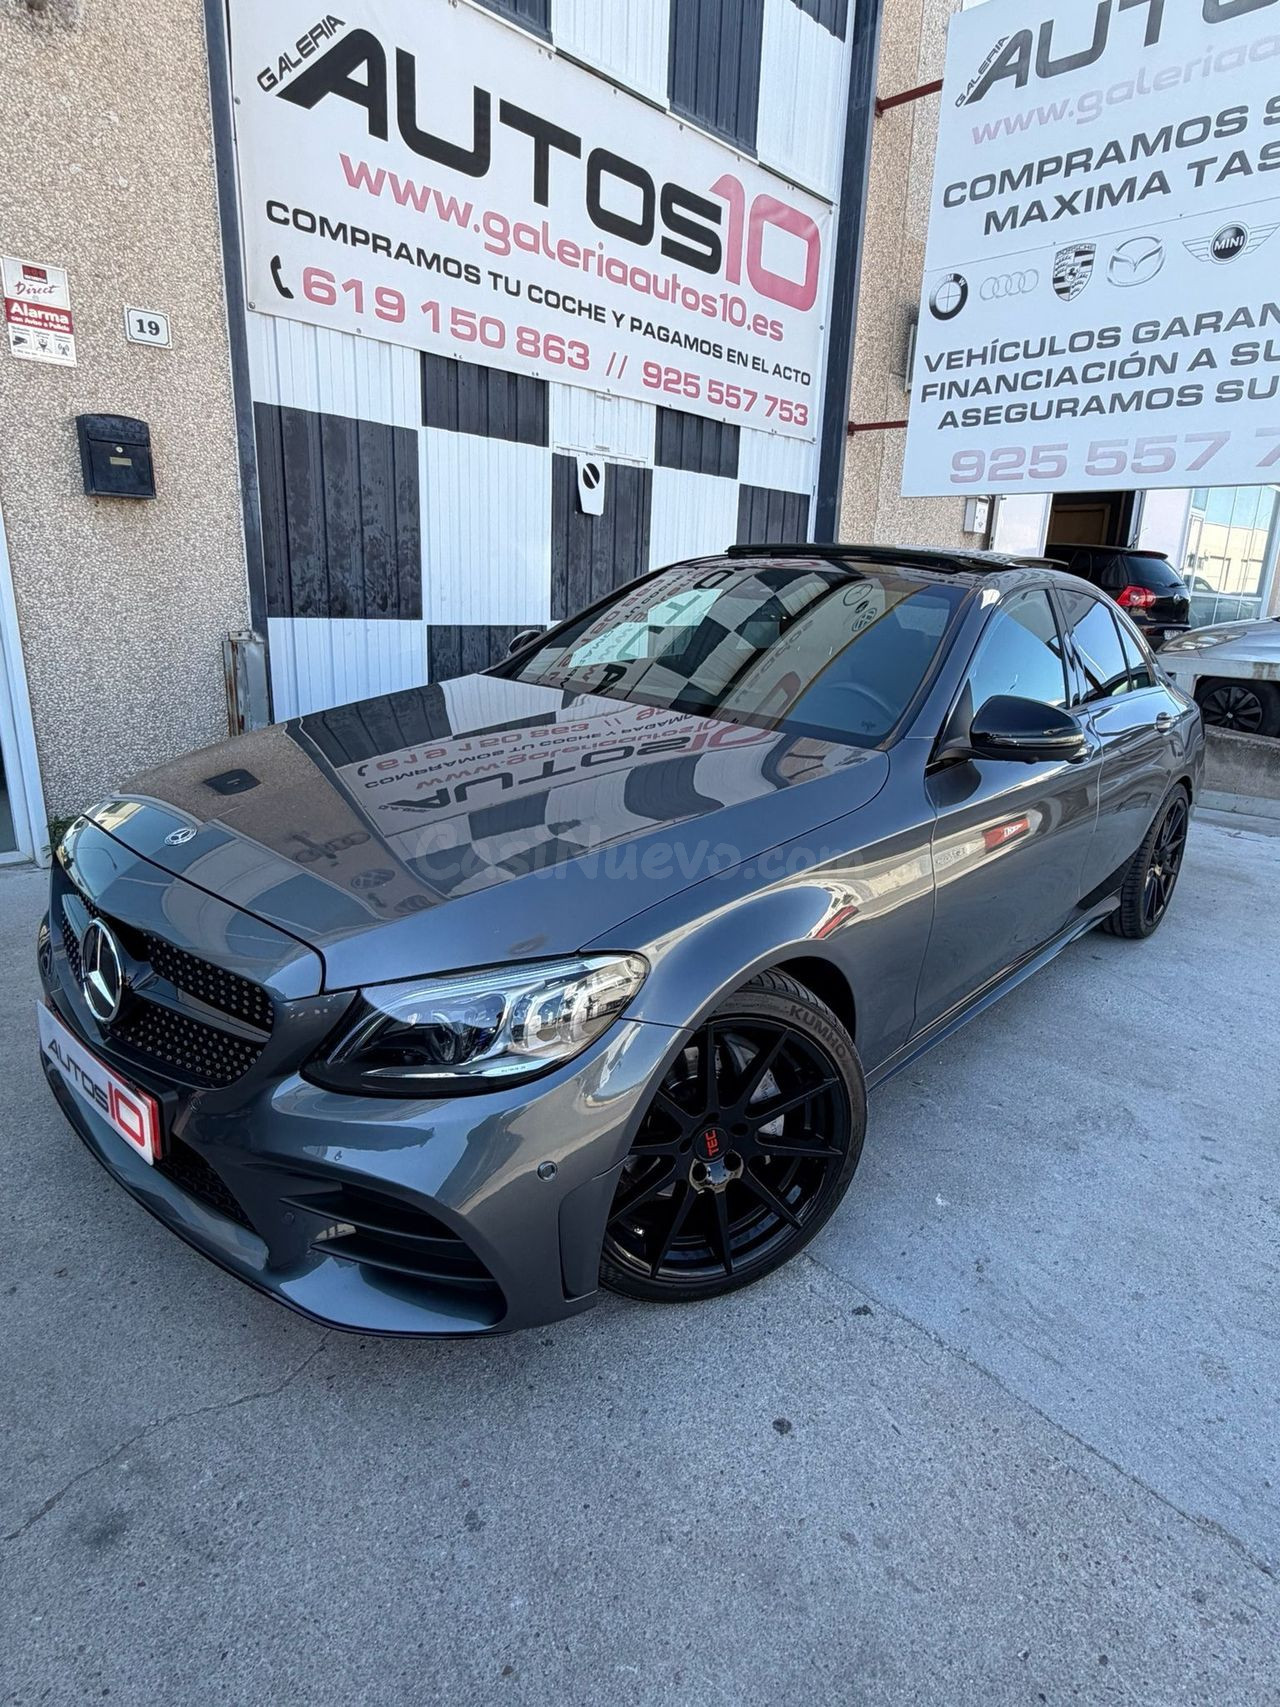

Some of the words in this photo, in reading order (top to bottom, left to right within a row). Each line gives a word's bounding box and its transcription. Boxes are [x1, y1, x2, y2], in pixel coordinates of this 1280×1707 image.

[257, 14, 346, 93] GALERIA
[955, 35, 1010, 107] GALERIA
[276, 28, 820, 312] AUTOS10
[943, 105, 1249, 209] COMPRAMOS
[984, 169, 1172, 237] MAXIMA
[339, 153, 784, 342] www.galeriaautos10.es
[1213, 234, 1245, 251] MINI
[10, 302, 69, 325] Alarma
[15, 281, 57, 295] Direct
[266, 200, 481, 285] COMPRAMOS
[488, 270, 521, 298] TU
[528, 284, 606, 325] COCHE
[612, 309, 625, 330] Y
[630, 316, 722, 359] PAGAMOS
[726, 344, 748, 366] EN
[752, 352, 770, 373] EL
[773, 357, 811, 386] ACTO
[136, 318, 160, 337] 19
[302, 266, 405, 323] 619
[422, 301, 506, 349] 150
[516, 326, 590, 372] 863
[643, 361, 700, 397] 925
[707, 382, 759, 414] 557
[764, 394, 809, 427] 753
[924, 326, 1121, 373] VEHÍCULOS
[921, 351, 1178, 403] FINANCIACIÓN
[1187, 347, 1217, 372] A
[938, 385, 1203, 430] ASEGURAMOS
[949, 442, 1069, 484] 925
[1084, 430, 1231, 476] 557
[789, 1005, 847, 1058] KUMHO
[48, 1038, 145, 1147] AUTOS10
[705, 1129, 718, 1157] TEC
